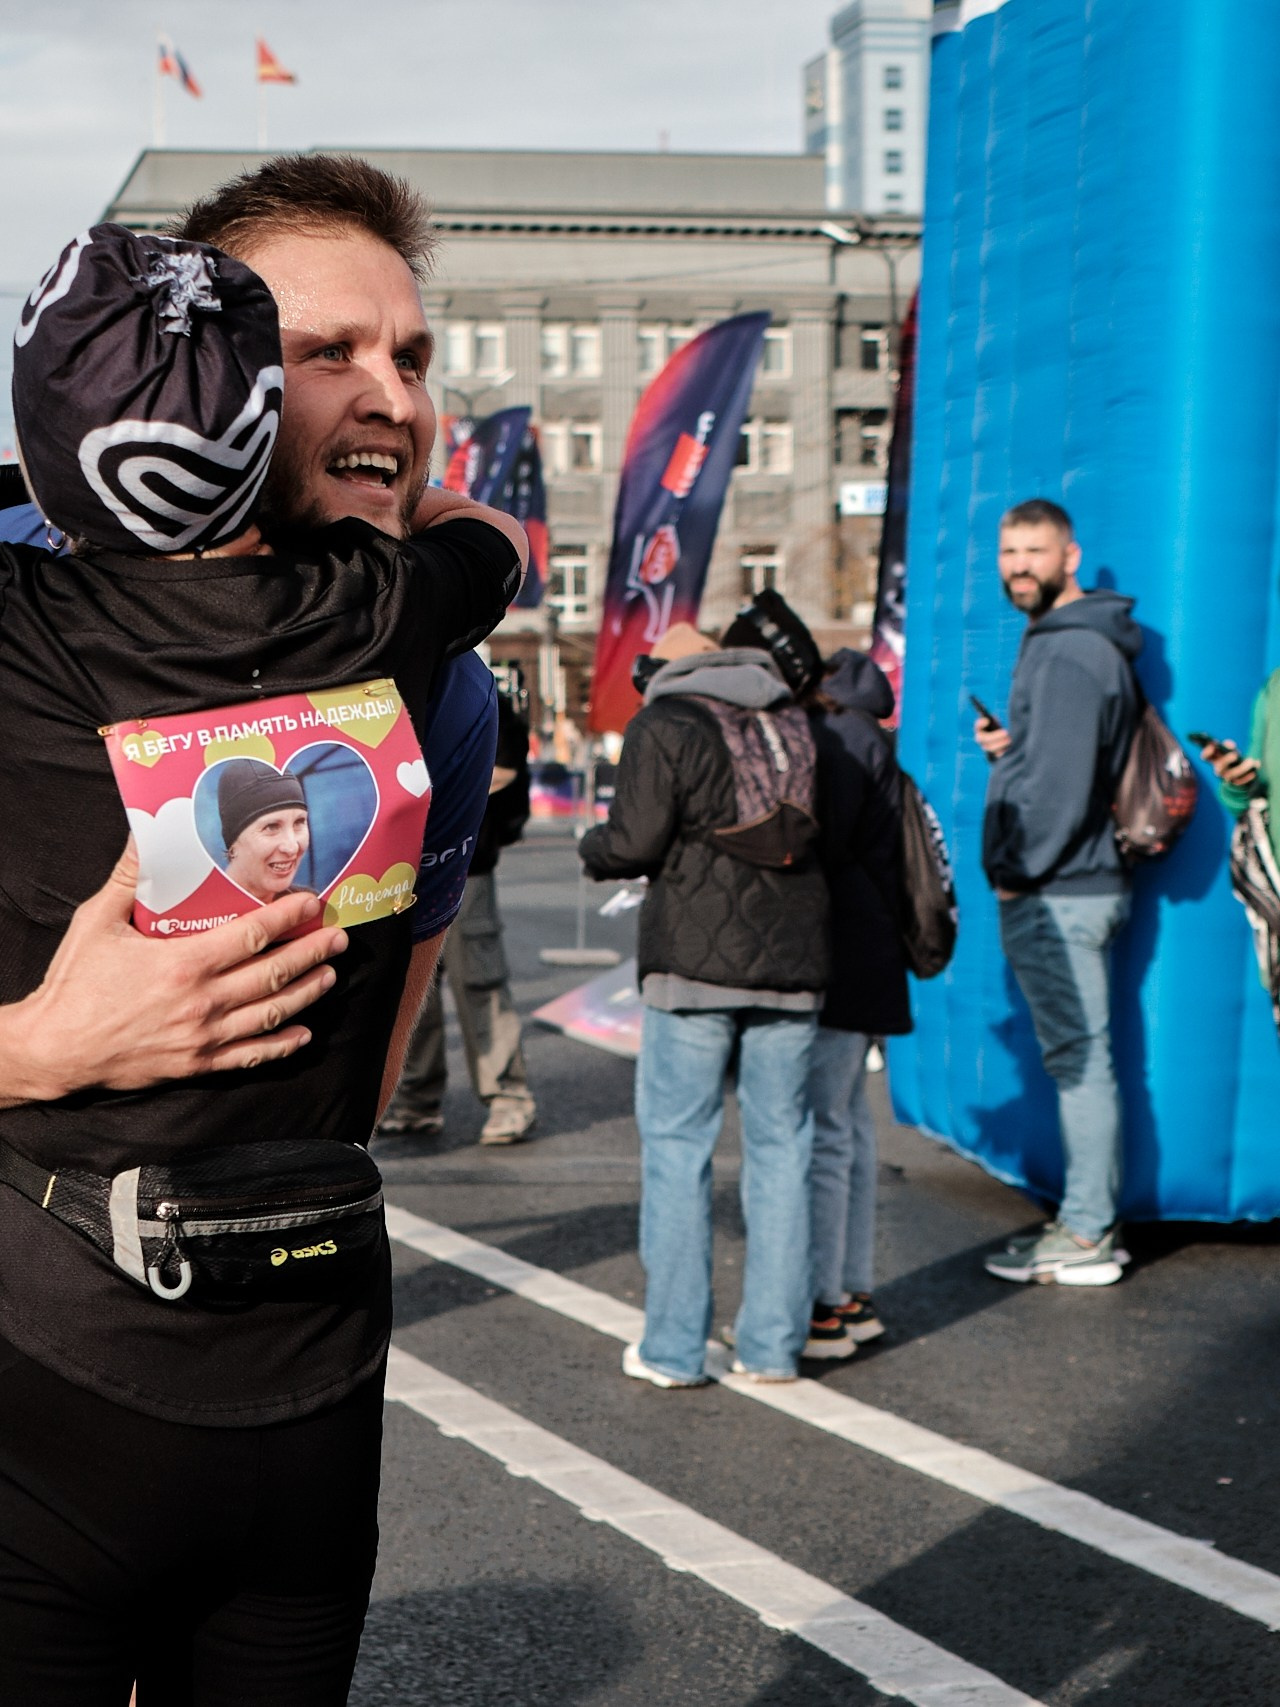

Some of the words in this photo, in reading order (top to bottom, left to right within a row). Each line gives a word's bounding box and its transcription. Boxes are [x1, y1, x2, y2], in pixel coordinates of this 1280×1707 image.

[124, 743, 141, 761] Я
[142, 731, 193, 757] БЕГУ
[196, 728, 213, 747] В
[213, 714, 298, 744] ПАМЯТЬ
[299, 699, 396, 727] НАДЕЖДЫ!
[338, 880, 410, 913] Надежда
